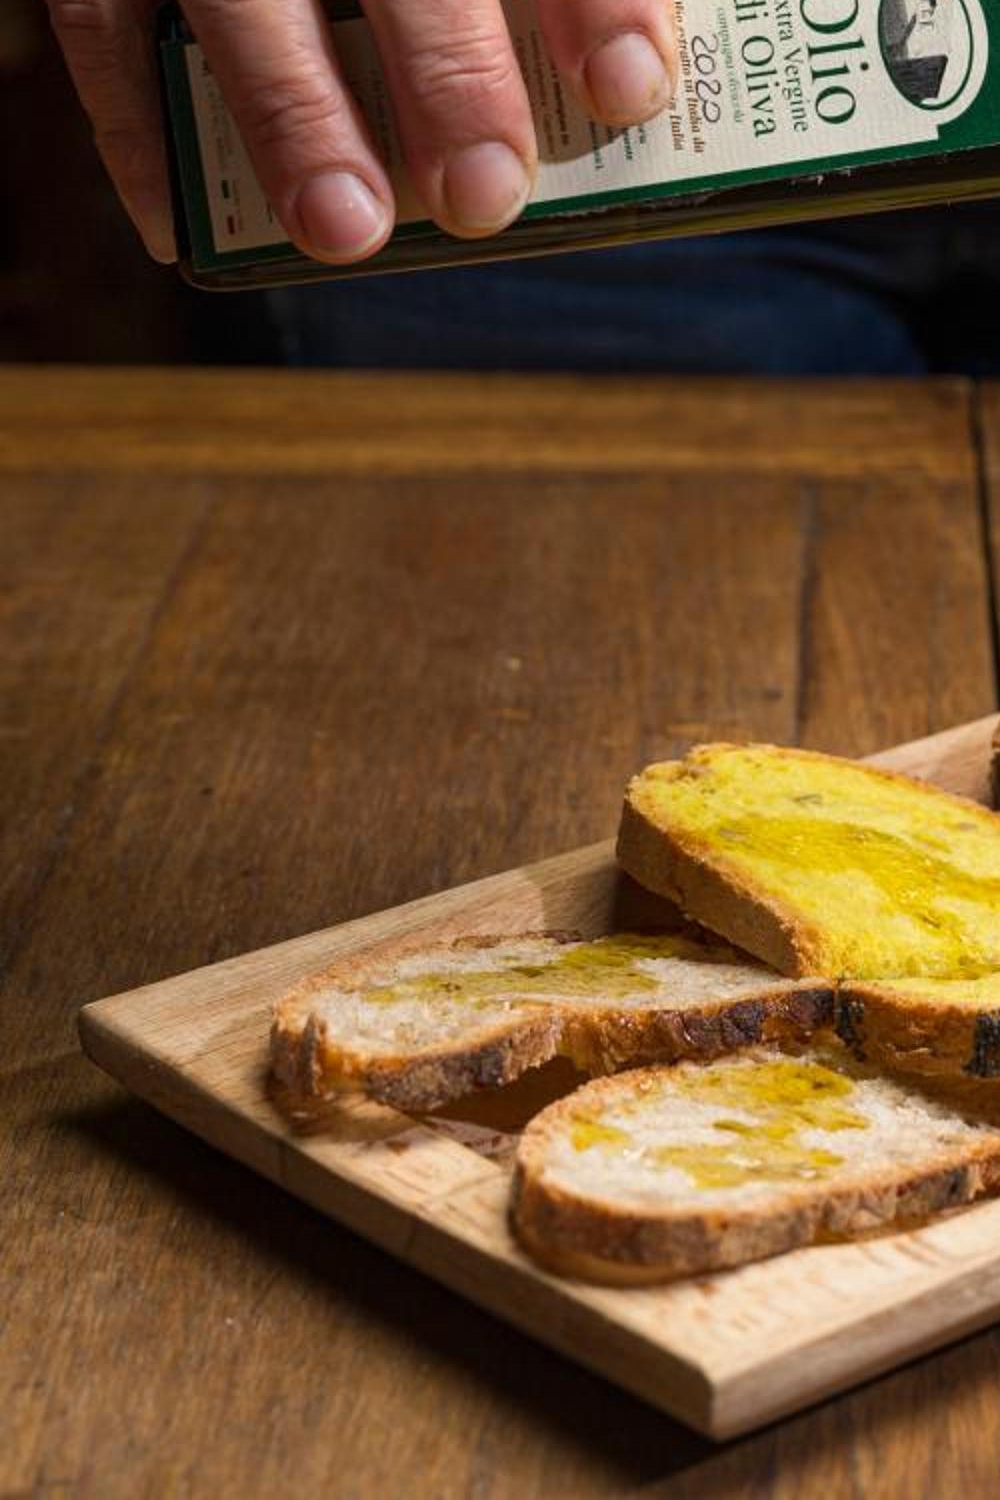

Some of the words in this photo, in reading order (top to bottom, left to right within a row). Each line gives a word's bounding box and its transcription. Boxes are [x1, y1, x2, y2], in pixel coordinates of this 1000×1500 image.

[686, 97, 702, 132] Italia
[691, 33, 722, 123] 2020
[741, 35, 780, 137] Oliva
[782, 47, 809, 132] Vergine
[669, 115, 685, 150] Italia
